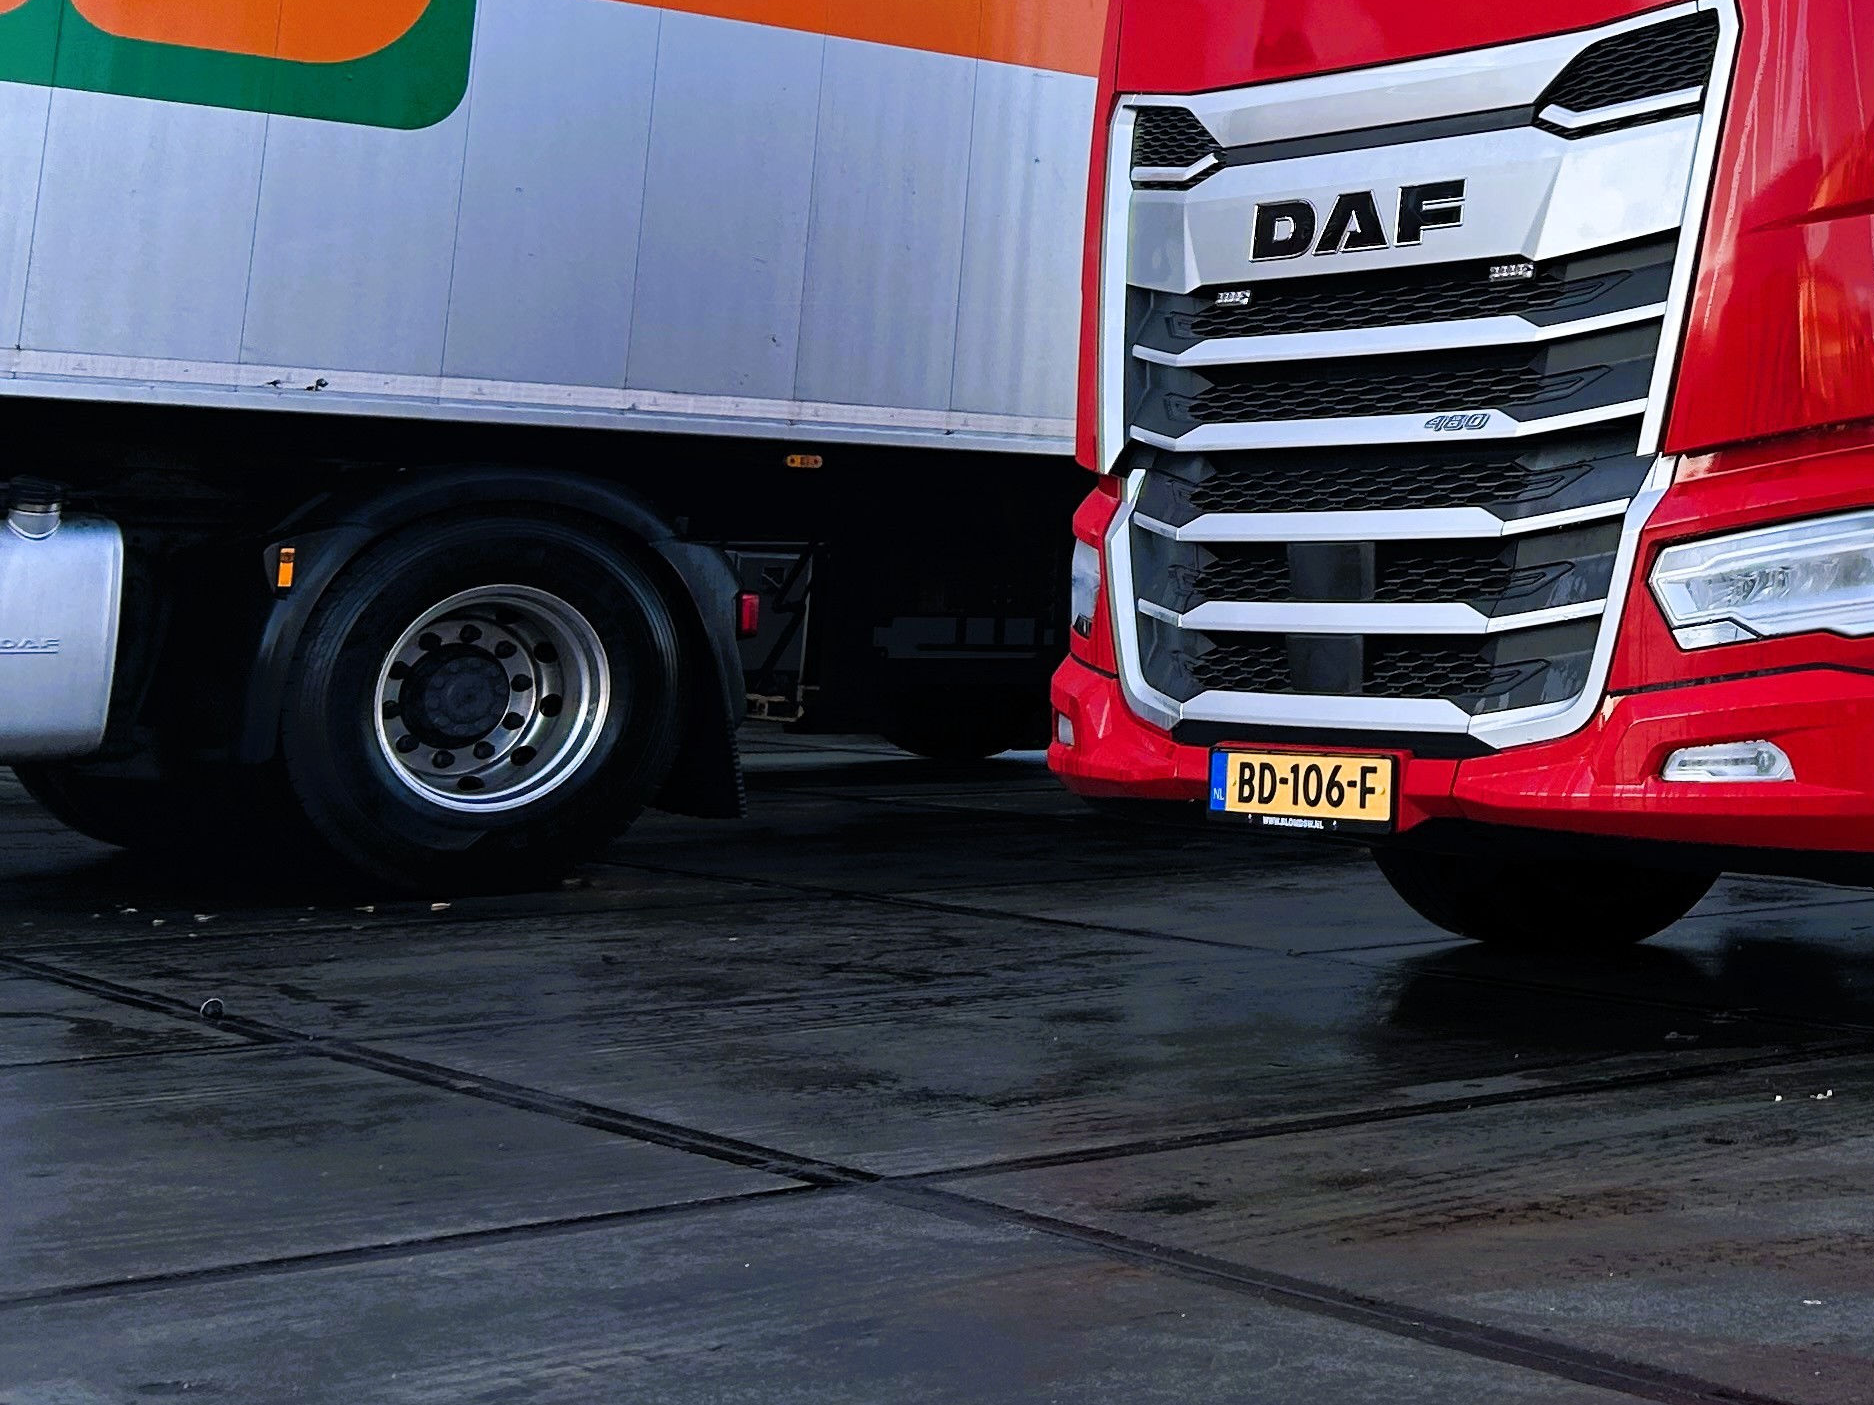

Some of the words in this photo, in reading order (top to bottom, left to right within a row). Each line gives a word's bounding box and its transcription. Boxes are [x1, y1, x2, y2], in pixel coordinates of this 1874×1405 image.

[1248, 177, 1468, 263] DAF
[1423, 413, 1491, 432] 480
[1213, 787, 1225, 801] NL
[1237, 761, 1379, 810] BD-106-F
